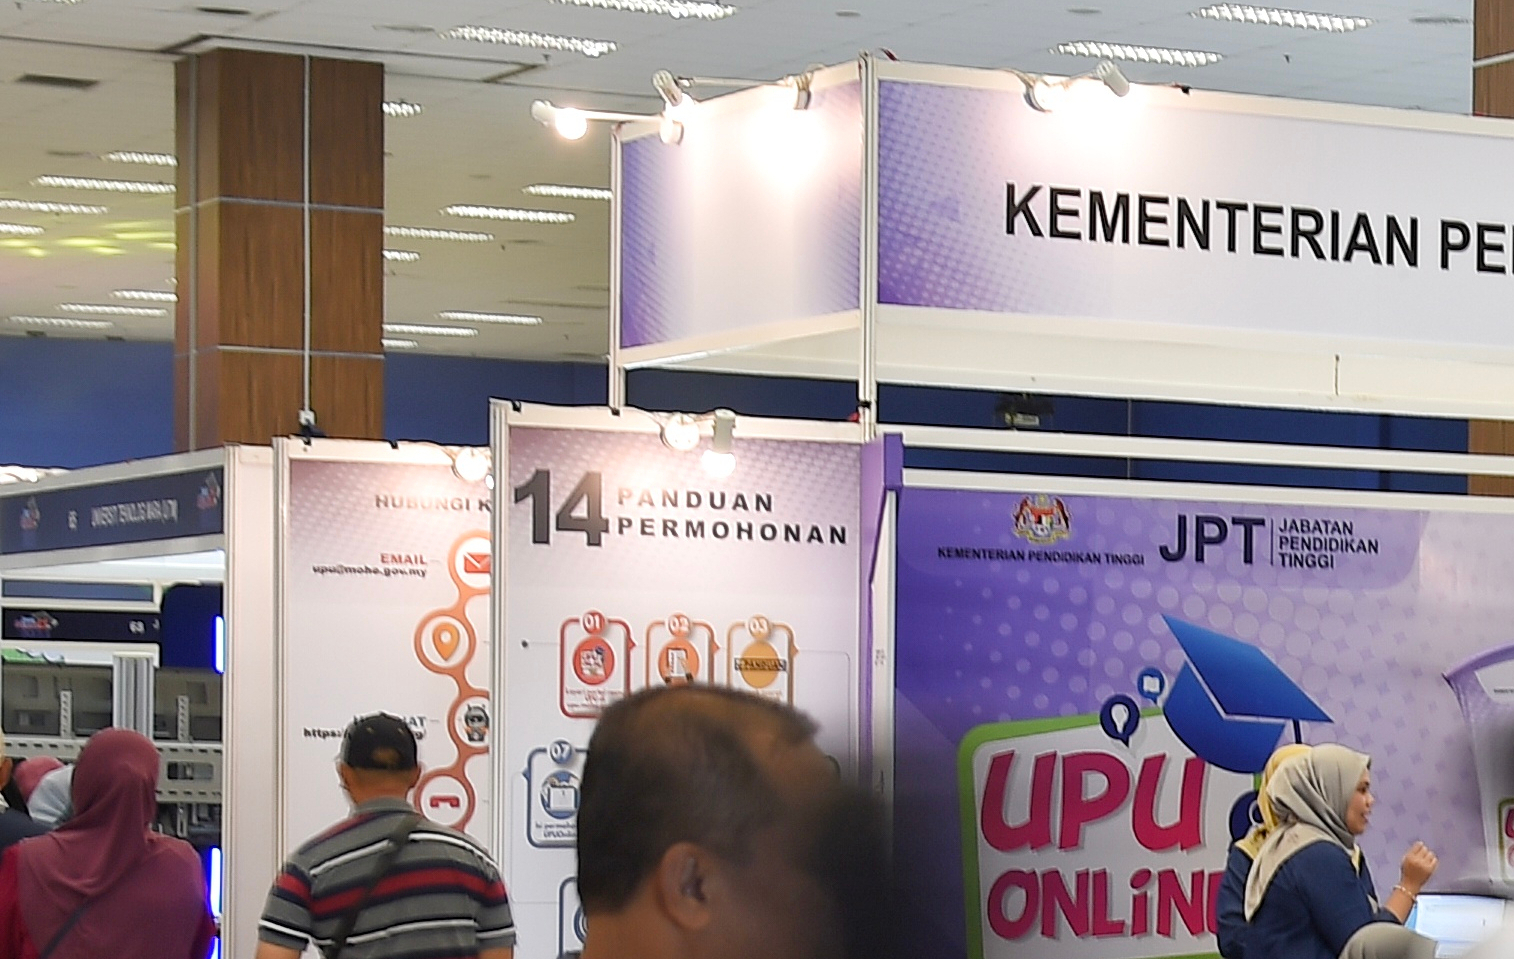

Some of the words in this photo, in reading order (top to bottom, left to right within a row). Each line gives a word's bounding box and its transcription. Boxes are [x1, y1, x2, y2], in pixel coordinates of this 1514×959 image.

[1002, 182, 1420, 268] KEMENTERIAN
[375, 494, 471, 511] HUBUNGI
[514, 469, 609, 547] 14
[617, 486, 773, 512] PANDUAN
[617, 517, 847, 545] PERMOHONAN
[1279, 518, 1354, 536] JABATAN
[1159, 514, 1266, 565] JPT
[1278, 536, 1379, 555] PENDIDIKAN
[380, 552, 428, 565] EMAIL
[938, 546, 1027, 562] KEMENTERIAN
[1028, 550, 1101, 564] PENDIDIKAN
[1105, 553, 1144, 567] TINGGI
[1278, 552, 1335, 570] TINGGI
[582, 615, 601, 629] 01
[669, 618, 688, 631] 02
[749, 618, 768, 632] 03
[980, 749, 1206, 852] UPU
